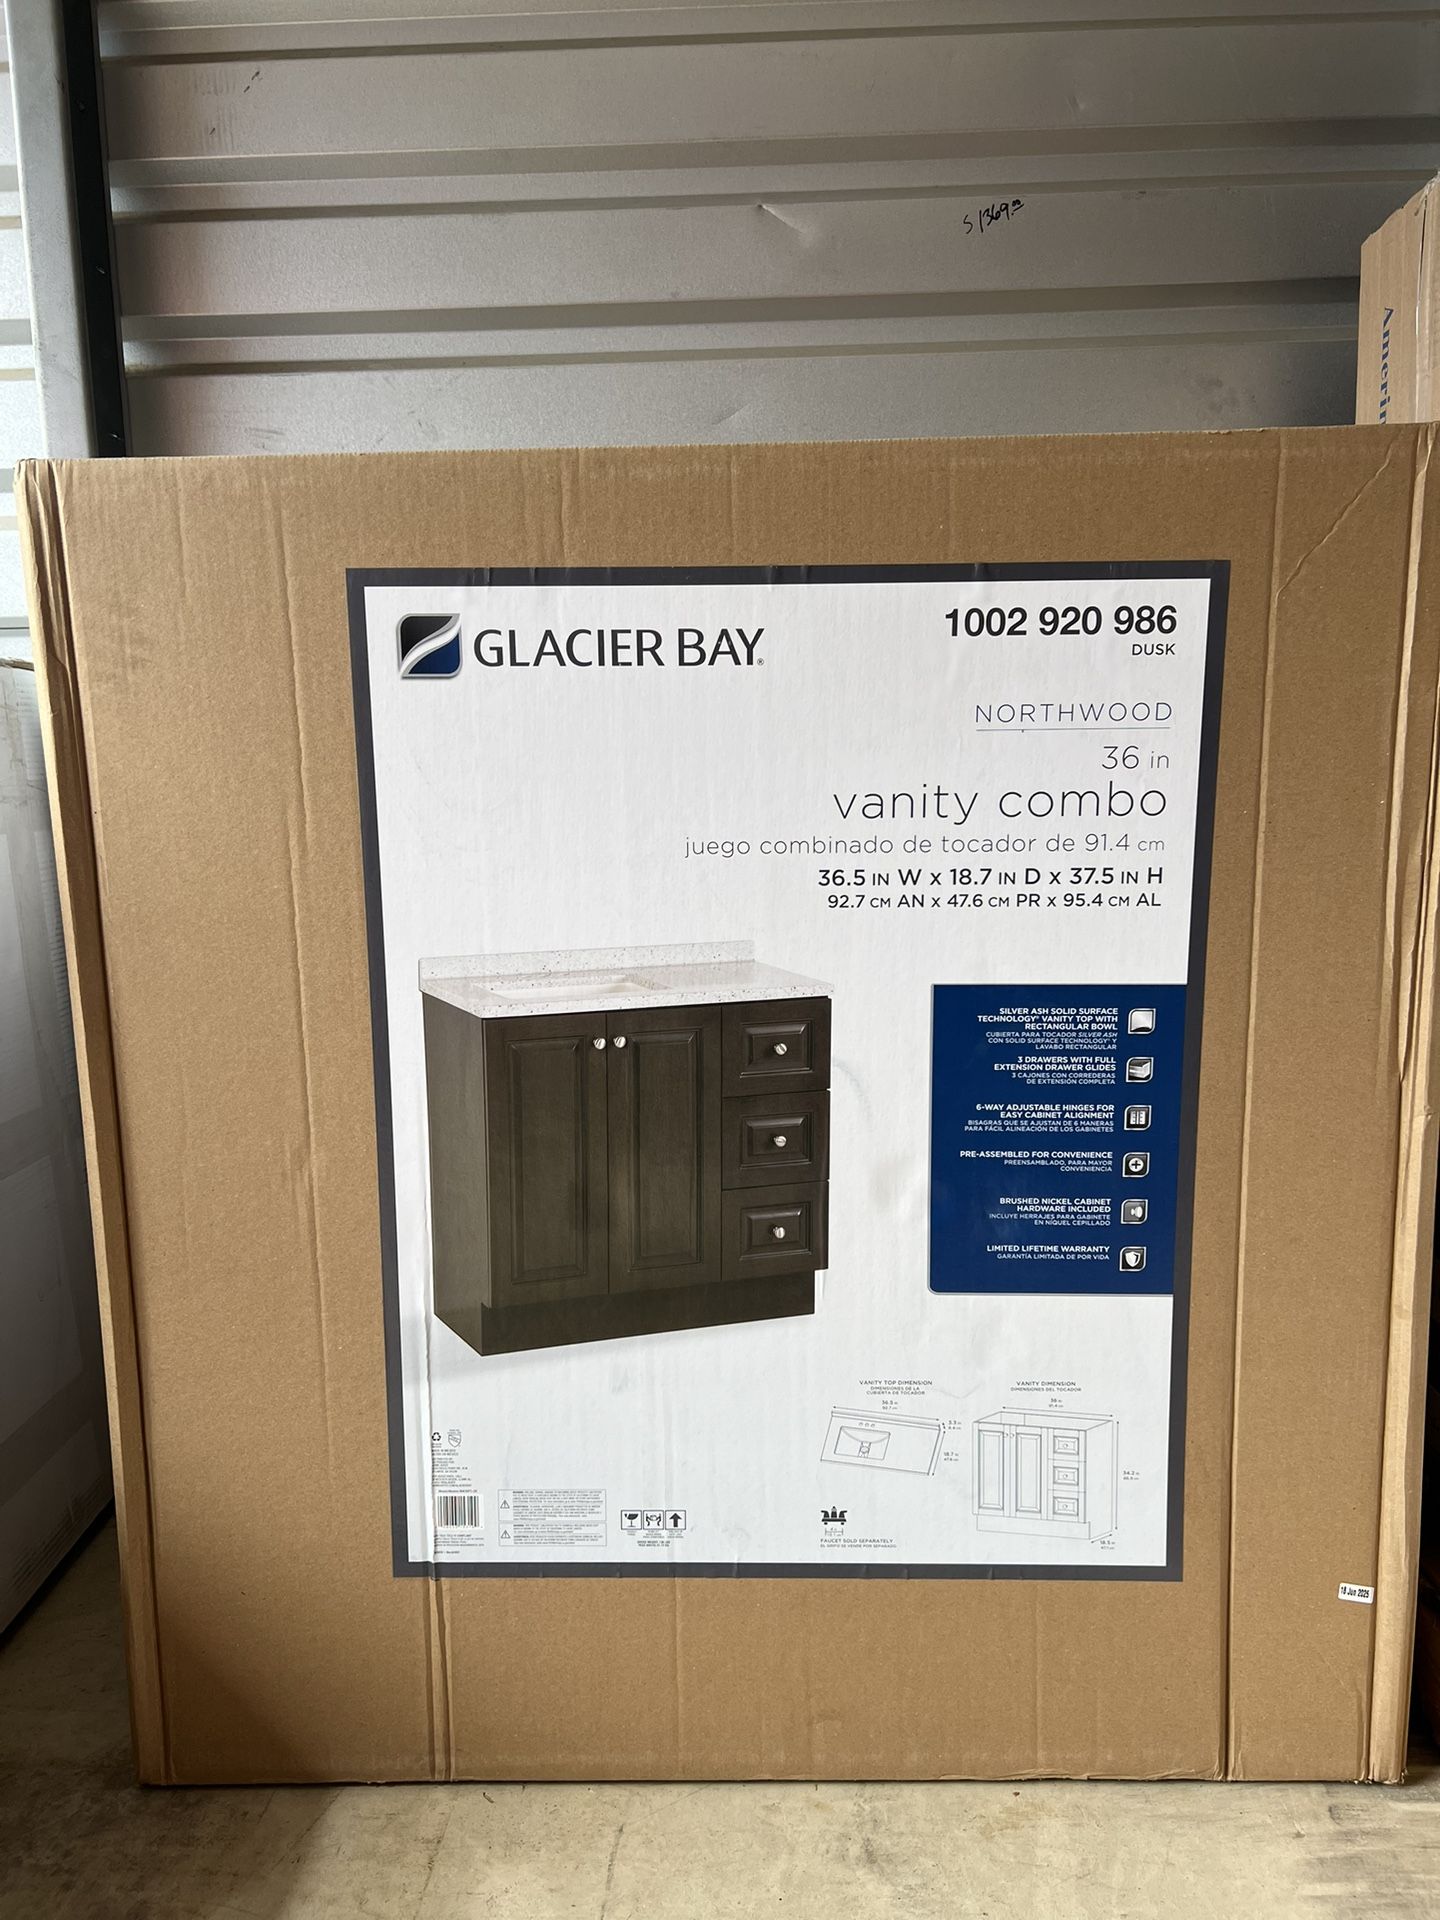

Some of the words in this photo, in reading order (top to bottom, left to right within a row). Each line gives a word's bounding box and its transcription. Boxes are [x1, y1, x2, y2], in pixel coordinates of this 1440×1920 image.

[945, 607, 1027, 637] 1002
[1039, 606, 1102, 635] 920
[1114, 605, 1177, 634] 986
[474, 629, 664, 667] GLACIER
[1132, 644, 1176, 655] DUSK
[976, 702, 1172, 723] NORTHWOOD
[1102, 745, 1139, 769] 36
[1151, 751, 1169, 768] in
[833, 784, 978, 825] vanity
[999, 781, 1166, 817] combo
[685, 837, 750, 858] juego
[760, 835, 893, 854] combinado
[903, 835, 931, 853] de
[942, 835, 1036, 852] tocador
[1046, 834, 1075, 851] de
[1085, 833, 1130, 851] 91.4
[1138, 840, 1165, 851] cm
[818, 870, 865, 886] 36.5
[873, 873, 889, 885] IN
[898, 869, 922, 885] W
[930, 872, 942, 885] x
[950, 868, 992, 885] 18.7
[999, 872, 1015, 884] IN
[1025, 868, 1040, 884] D
[1050, 871, 1061, 884] x
[1070, 868, 1113, 884] 37.5
[1121, 871, 1138, 883] IN
[1148, 867, 1163, 883] H
[828, 895, 865, 908] 92.7
[870, 898, 891, 908] CM
[898, 894, 924, 908] AN
[931, 897, 940, 907] x
[947, 894, 983, 907] 47.6
[989, 897, 1009, 907] CM
[1016, 894, 1040, 907] PR
[1047, 896, 1056, 907] x
[1063, 893, 1103, 906] 95.4
[1109, 896, 1129, 906] CM
[1136, 893, 1161, 906] AL
